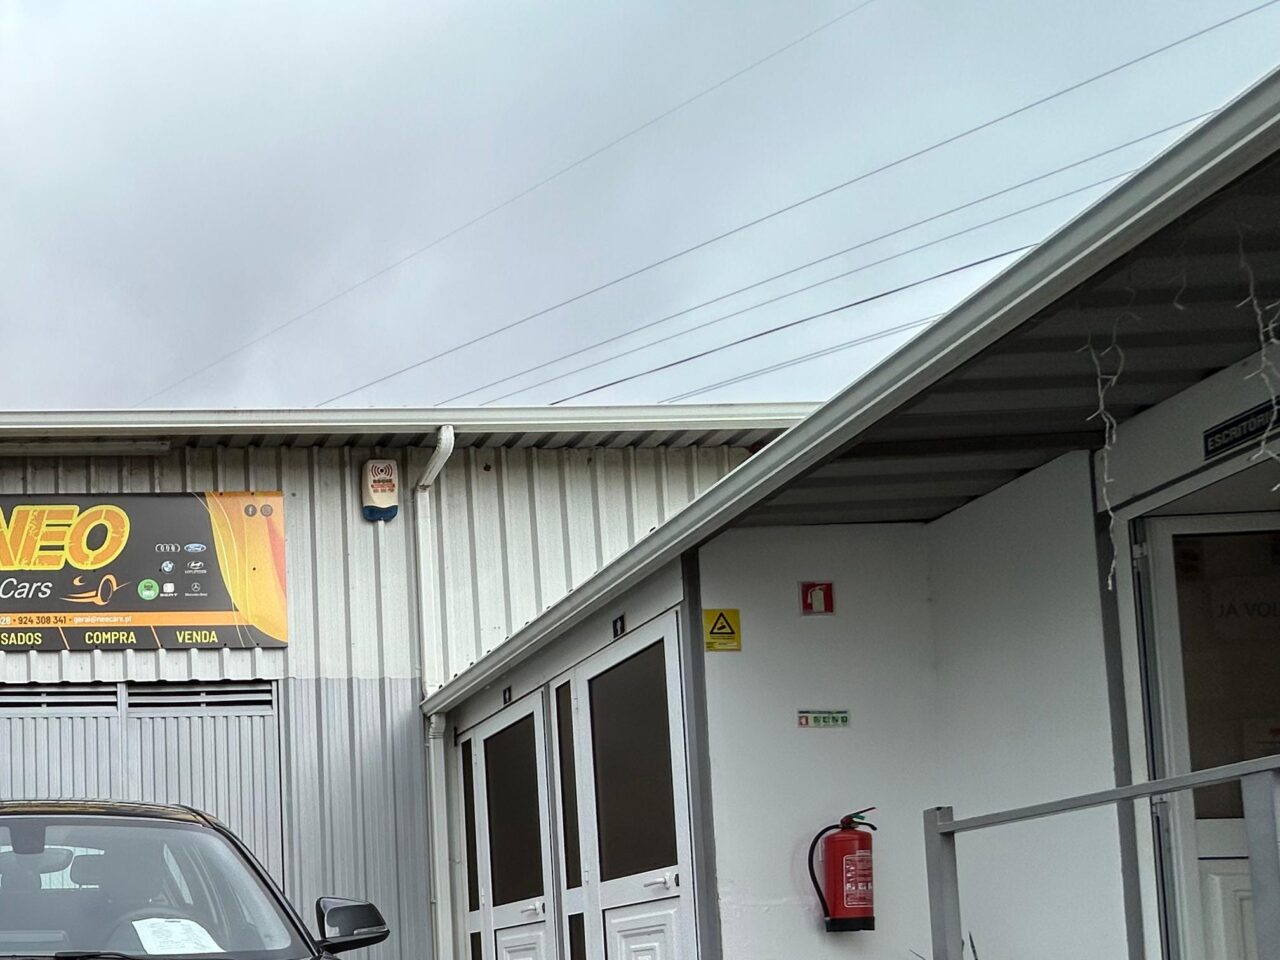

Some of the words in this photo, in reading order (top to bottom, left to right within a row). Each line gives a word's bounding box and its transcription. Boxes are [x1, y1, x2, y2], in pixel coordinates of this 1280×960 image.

[1207, 409, 1276, 451] ESCRITÓRI
[17, 616, 33, 625] 924
[35, 616, 51, 624] 308
[52, 615, 67, 624] 341
[85, 631, 137, 644] COMPRA
[176, 630, 219, 643] VENDA
